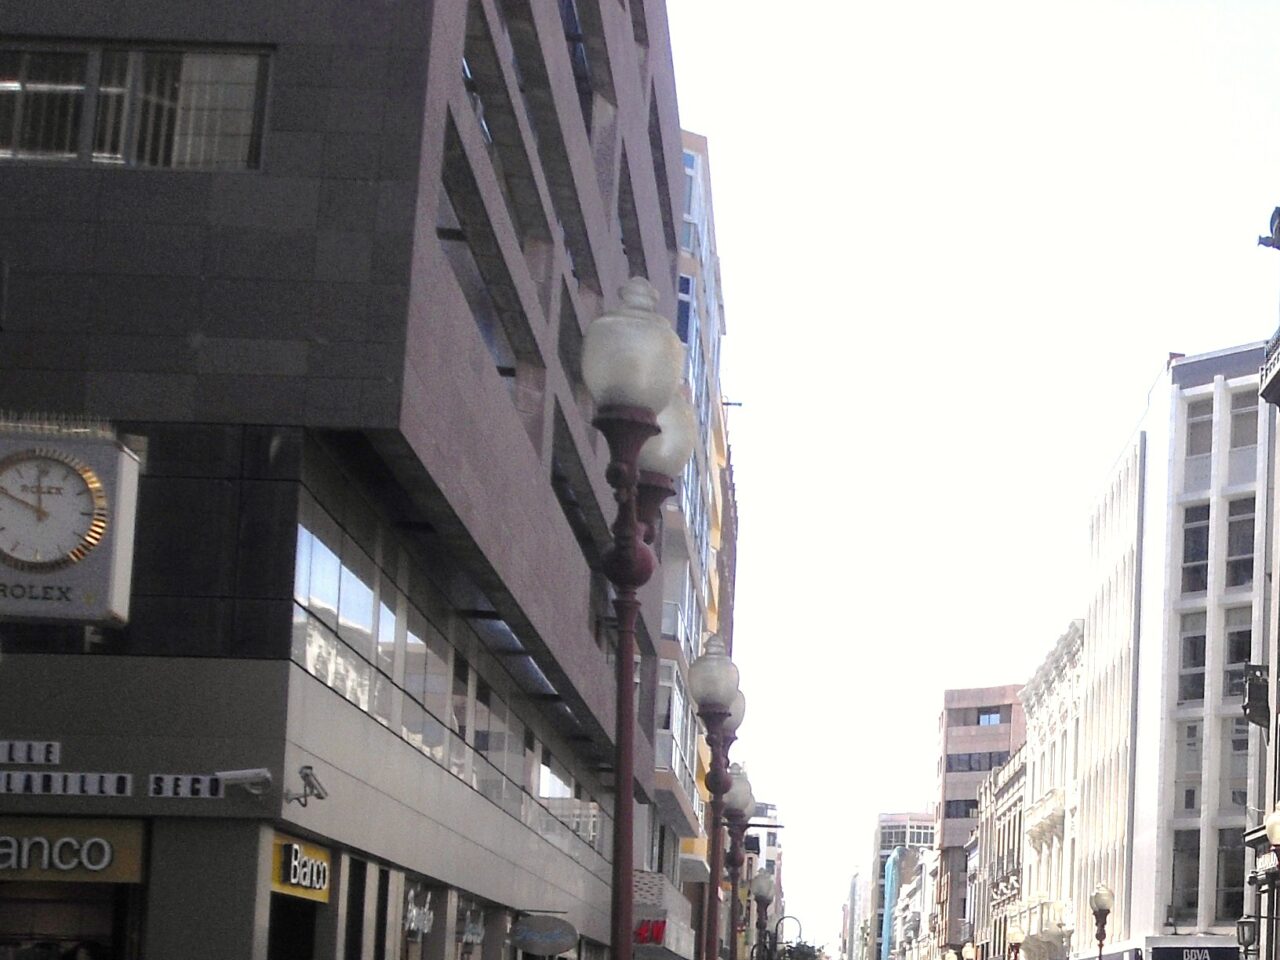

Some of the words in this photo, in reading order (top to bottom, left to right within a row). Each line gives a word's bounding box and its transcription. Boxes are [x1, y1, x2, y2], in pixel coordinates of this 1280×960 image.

[20, 484, 64, 496] ROLEX
[288, 843, 328, 891] Blanco
[1183, 949, 1211, 960] BBVA
